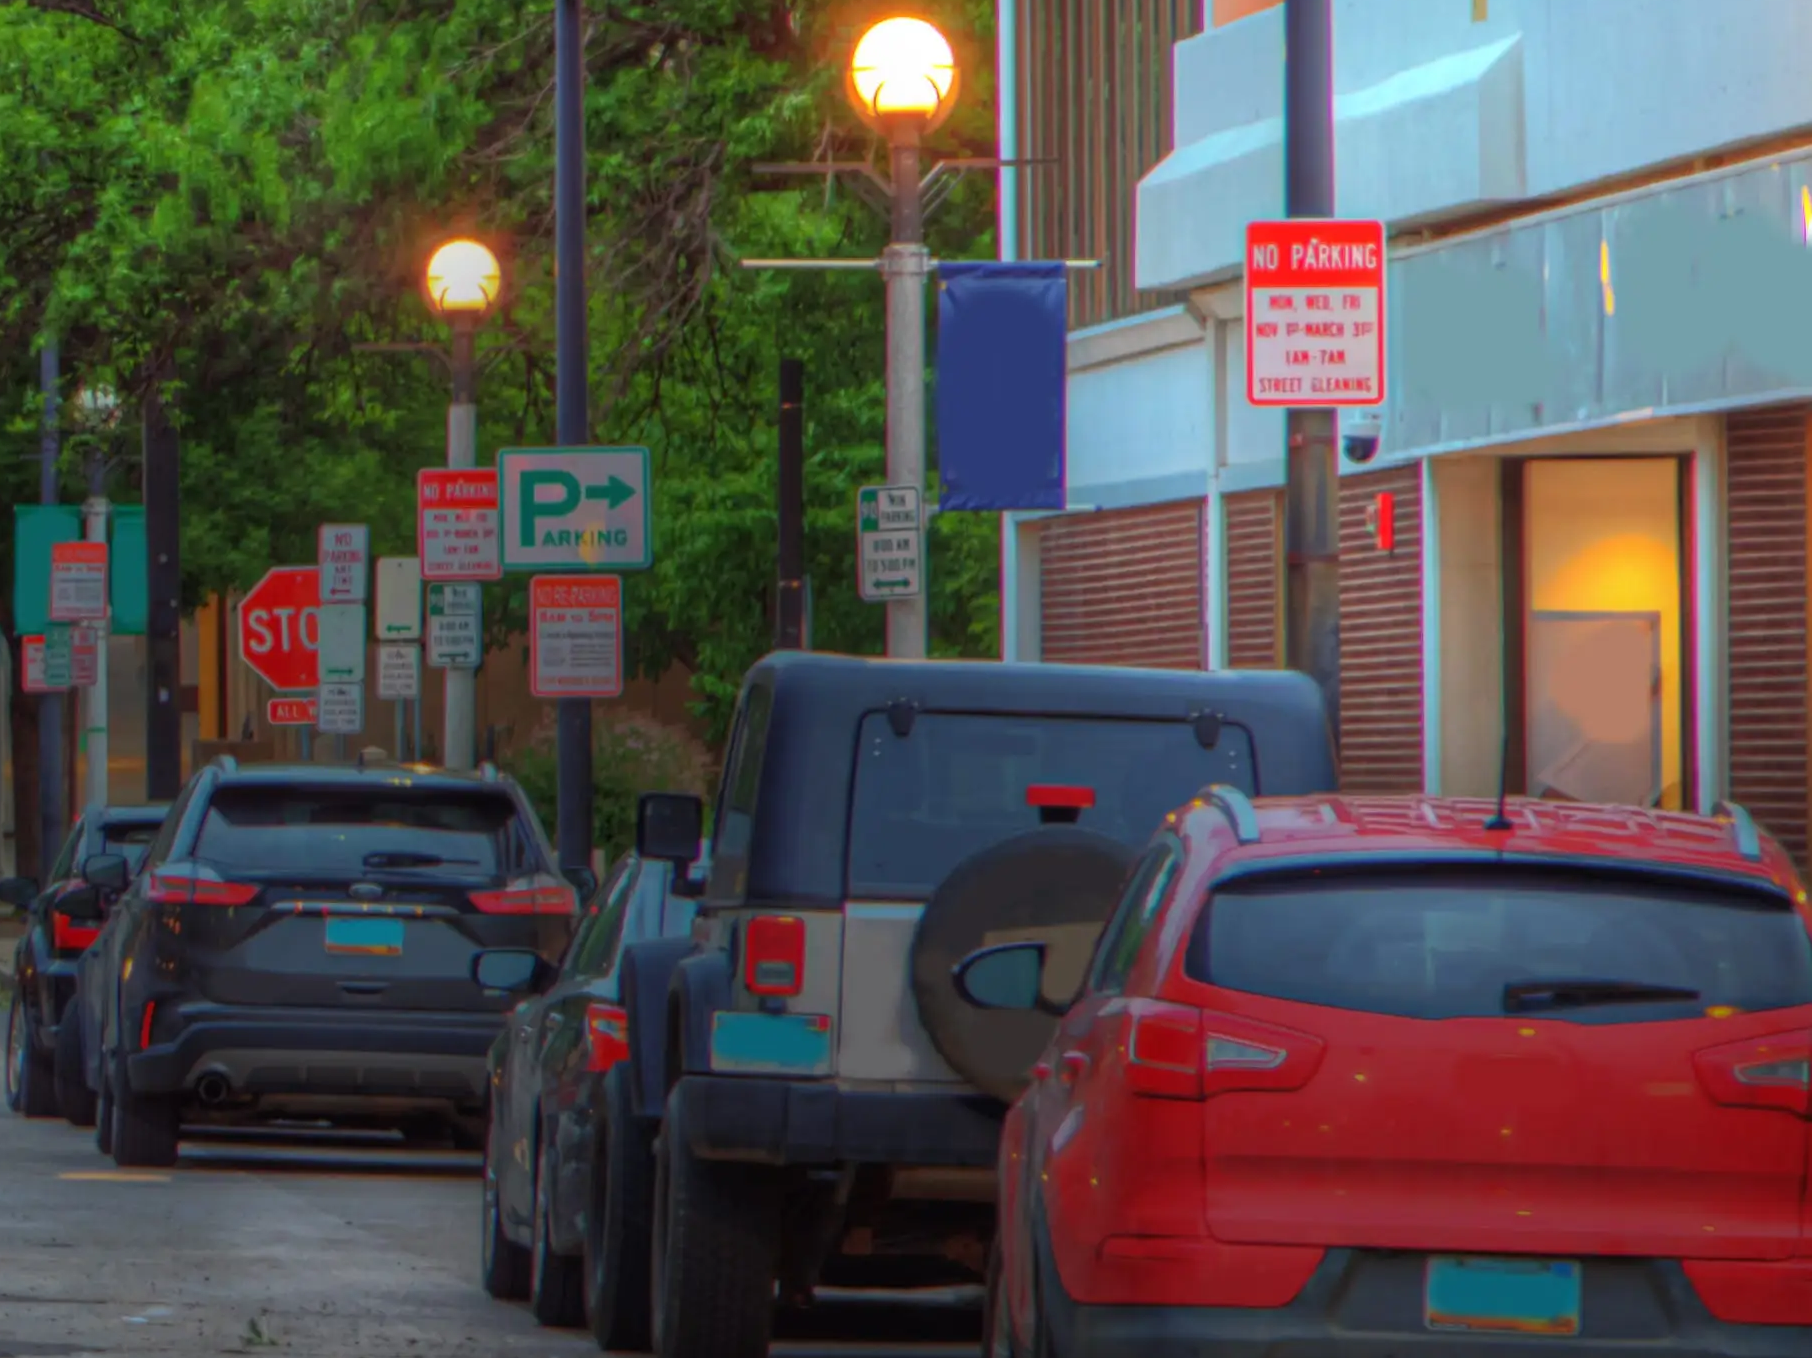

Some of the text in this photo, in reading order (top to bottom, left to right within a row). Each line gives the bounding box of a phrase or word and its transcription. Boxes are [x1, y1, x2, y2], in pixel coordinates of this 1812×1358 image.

[1253, 242, 1377, 270] NO PARKING
[1342, 295, 1361, 310] FRI
[1256, 322, 1279, 337] NOV
[1259, 377, 1372, 394] STREET CLEANING
[424, 482, 438, 500] NO
[334, 533, 352, 547] NO
[325, 550, 361, 563] PARKING
[248, 606, 320, 654] STO
[276, 704, 299, 718] ALL
